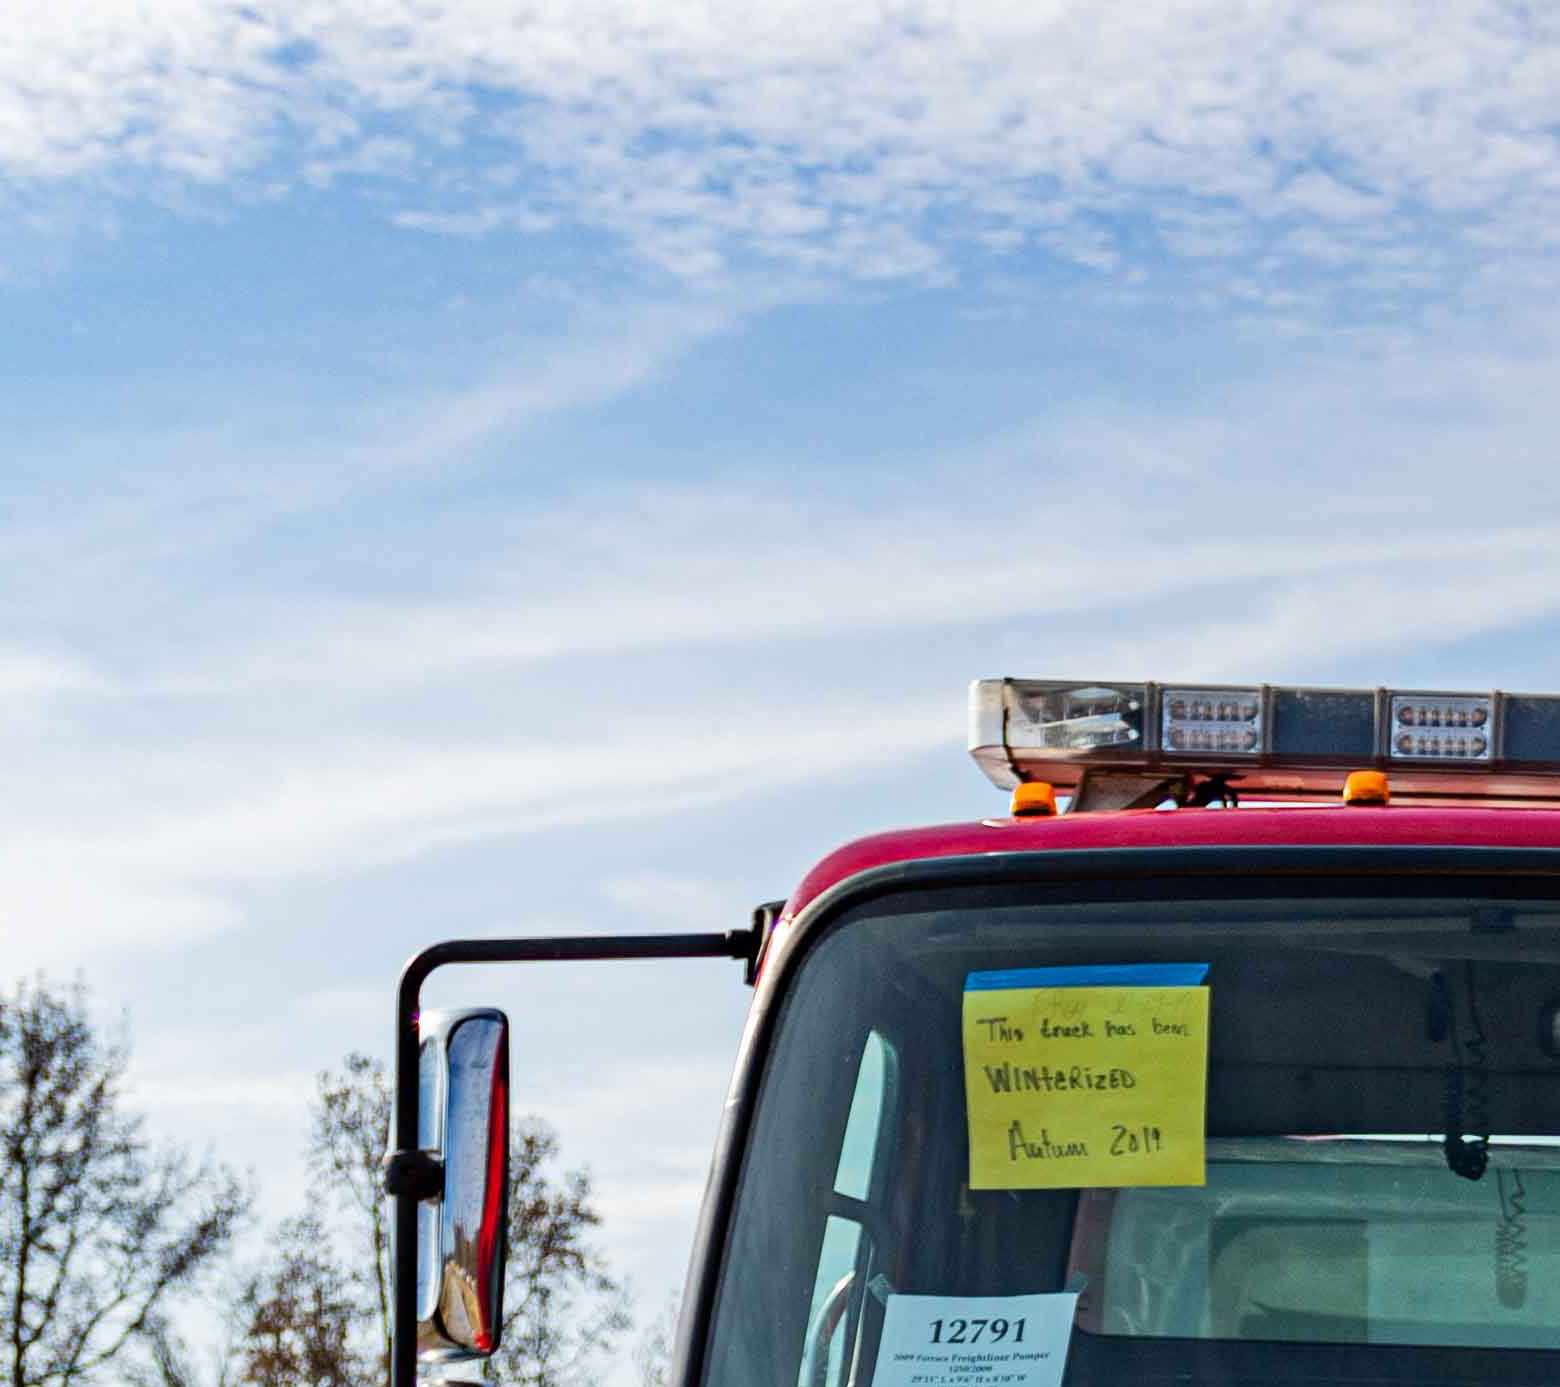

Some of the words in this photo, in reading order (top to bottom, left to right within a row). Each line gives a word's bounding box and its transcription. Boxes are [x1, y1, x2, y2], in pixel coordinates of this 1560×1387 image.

[976, 1017, 1023, 1042] This
[1040, 1018, 1093, 1039] truck
[1105, 1020, 1136, 1038] has
[1152, 1017, 1191, 1037] been
[1007, 1119, 1088, 1161] Autumn
[1109, 1125, 1161, 1156] 2019
[928, 1317, 1027, 1344] 12791
[951, 1351, 1010, 1364] Freightliner
